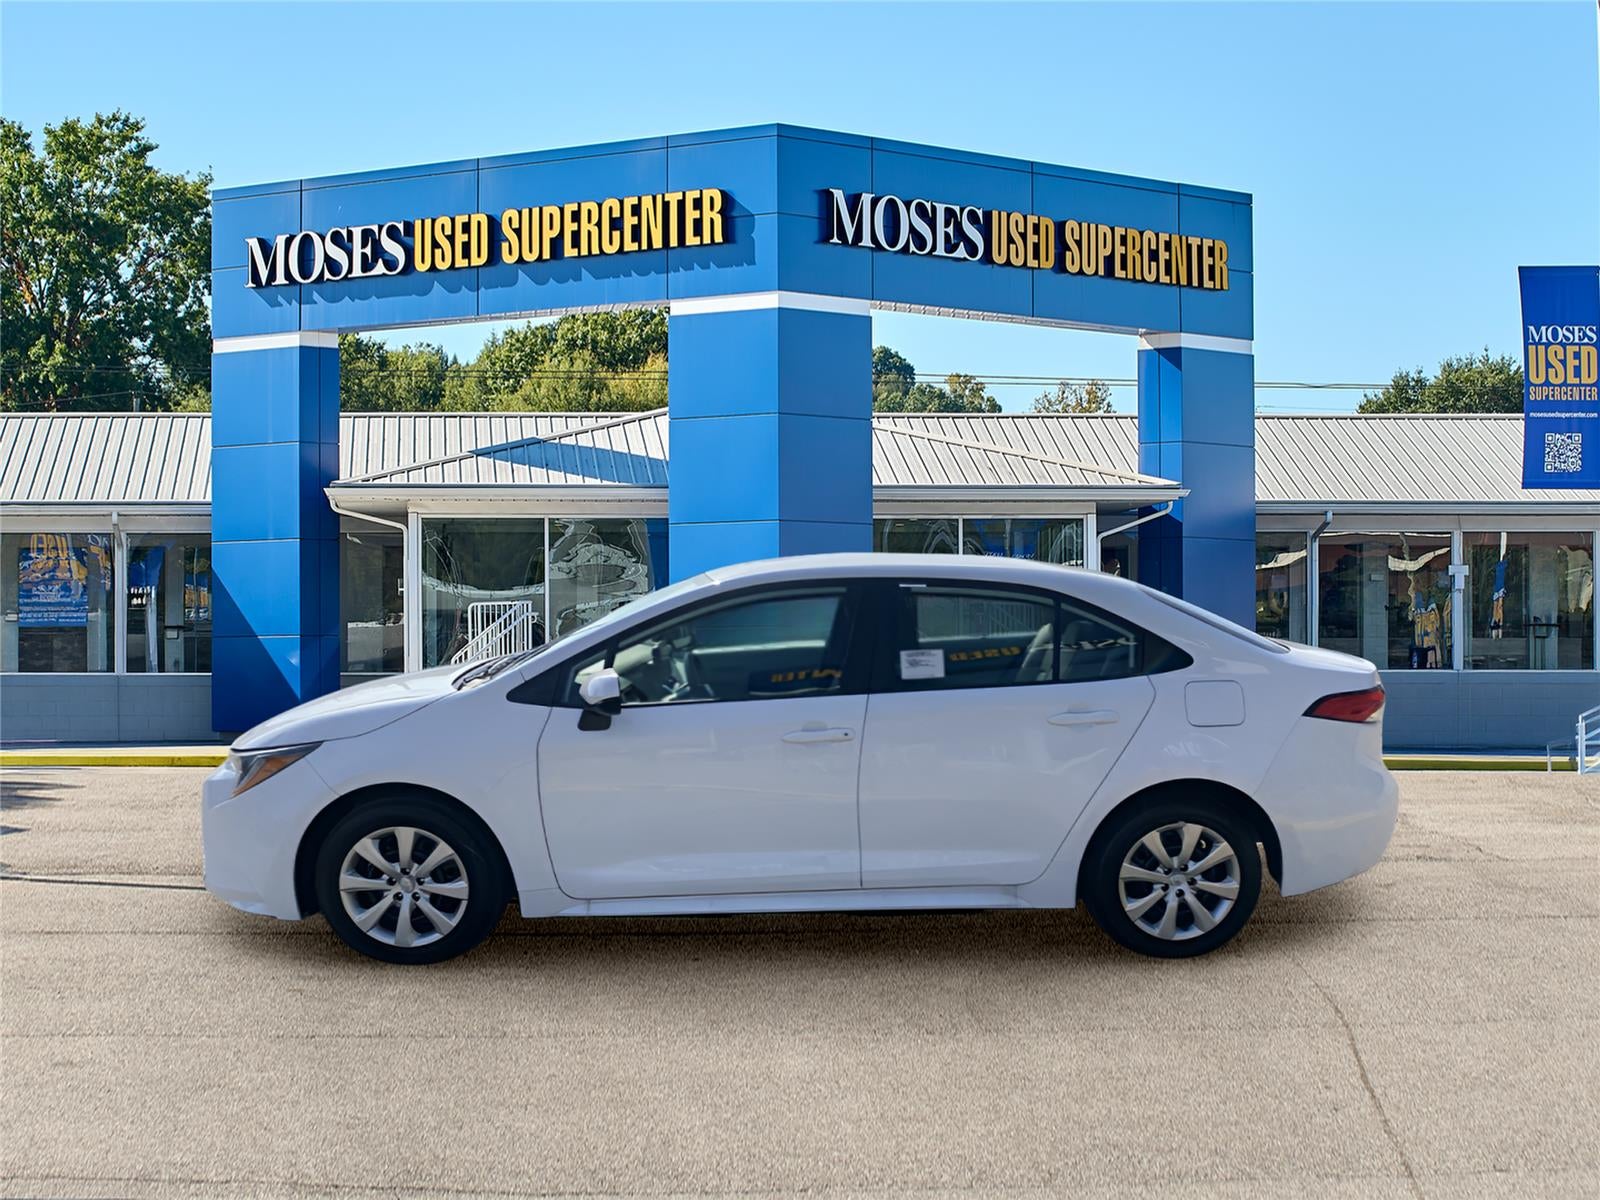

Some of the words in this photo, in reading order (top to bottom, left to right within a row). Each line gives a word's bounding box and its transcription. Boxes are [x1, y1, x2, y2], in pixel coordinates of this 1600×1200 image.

[244, 221, 406, 288] MOSES
[413, 213, 489, 272] USED
[501, 188, 725, 265] SUPERCENTER
[829, 188, 985, 261] MOSES
[991, 210, 1055, 270] USED
[1065, 219, 1230, 291] SUPERCENTER
[1528, 325, 1597, 343] MOSES
[1528, 345, 1598, 385] USED
[1529, 386, 1598, 401] SUPERCENTER
[1529, 411, 1598, 419] mosesusedsupercenter.com
